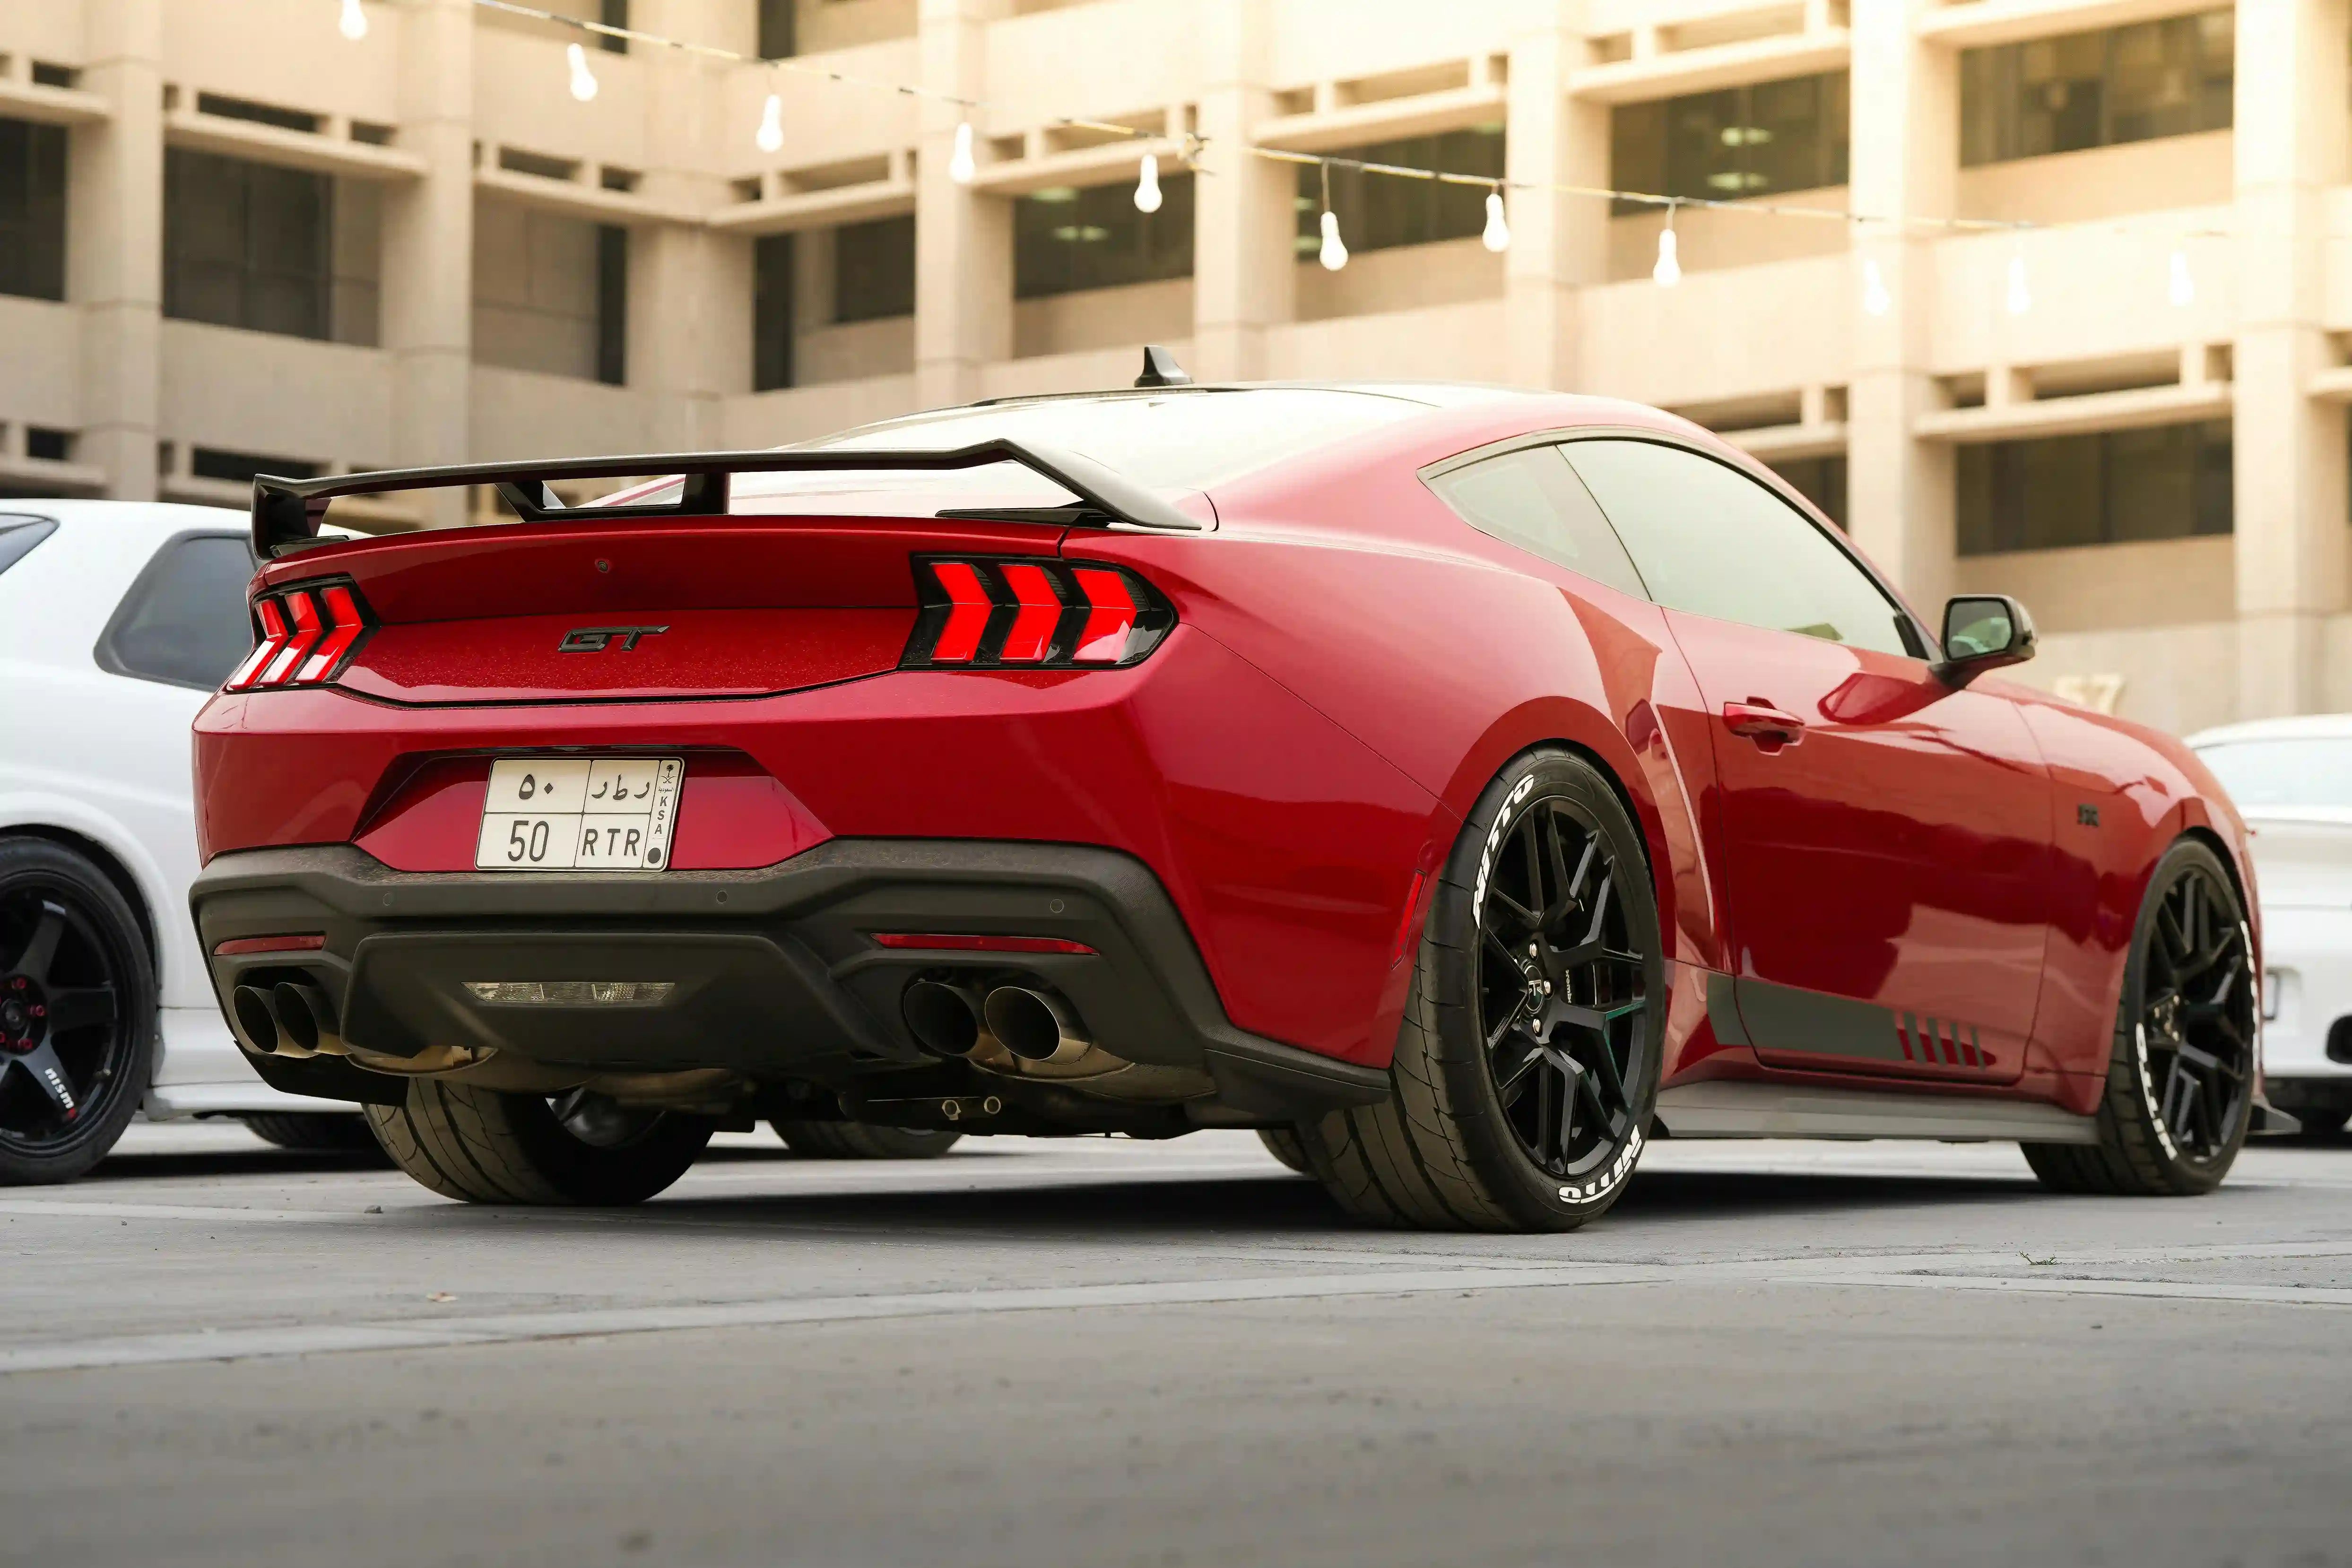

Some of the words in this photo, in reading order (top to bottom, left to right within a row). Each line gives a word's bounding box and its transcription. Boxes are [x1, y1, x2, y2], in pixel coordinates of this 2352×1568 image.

[557, 625, 670, 652] GT
[507, 820, 550, 862] 50
[581, 828, 641, 856] RTR
[1473, 774, 1534, 929] NITTO
[1559, 1125, 1642, 1204] NITTO
